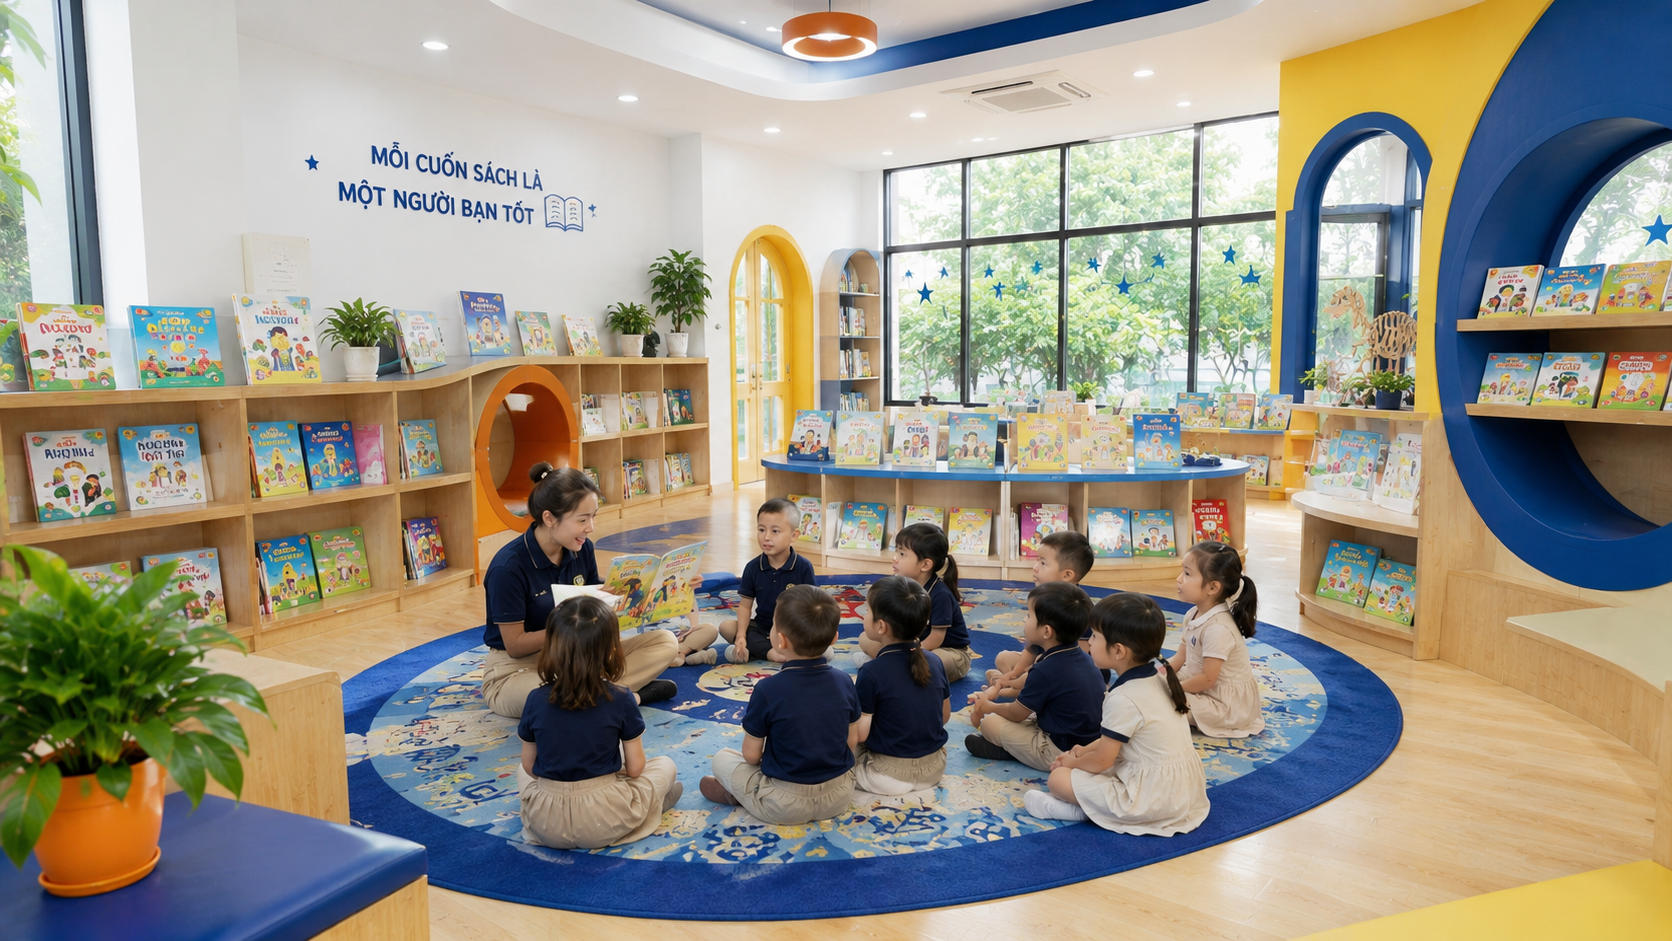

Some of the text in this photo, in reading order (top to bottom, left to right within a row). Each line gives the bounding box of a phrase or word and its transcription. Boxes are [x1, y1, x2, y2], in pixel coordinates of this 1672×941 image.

[371, 141, 543, 191] MỖI CUỐN SÁCH LÀ
[338, 179, 535, 225] MỘT NGƯỜI BẠN TỐT
